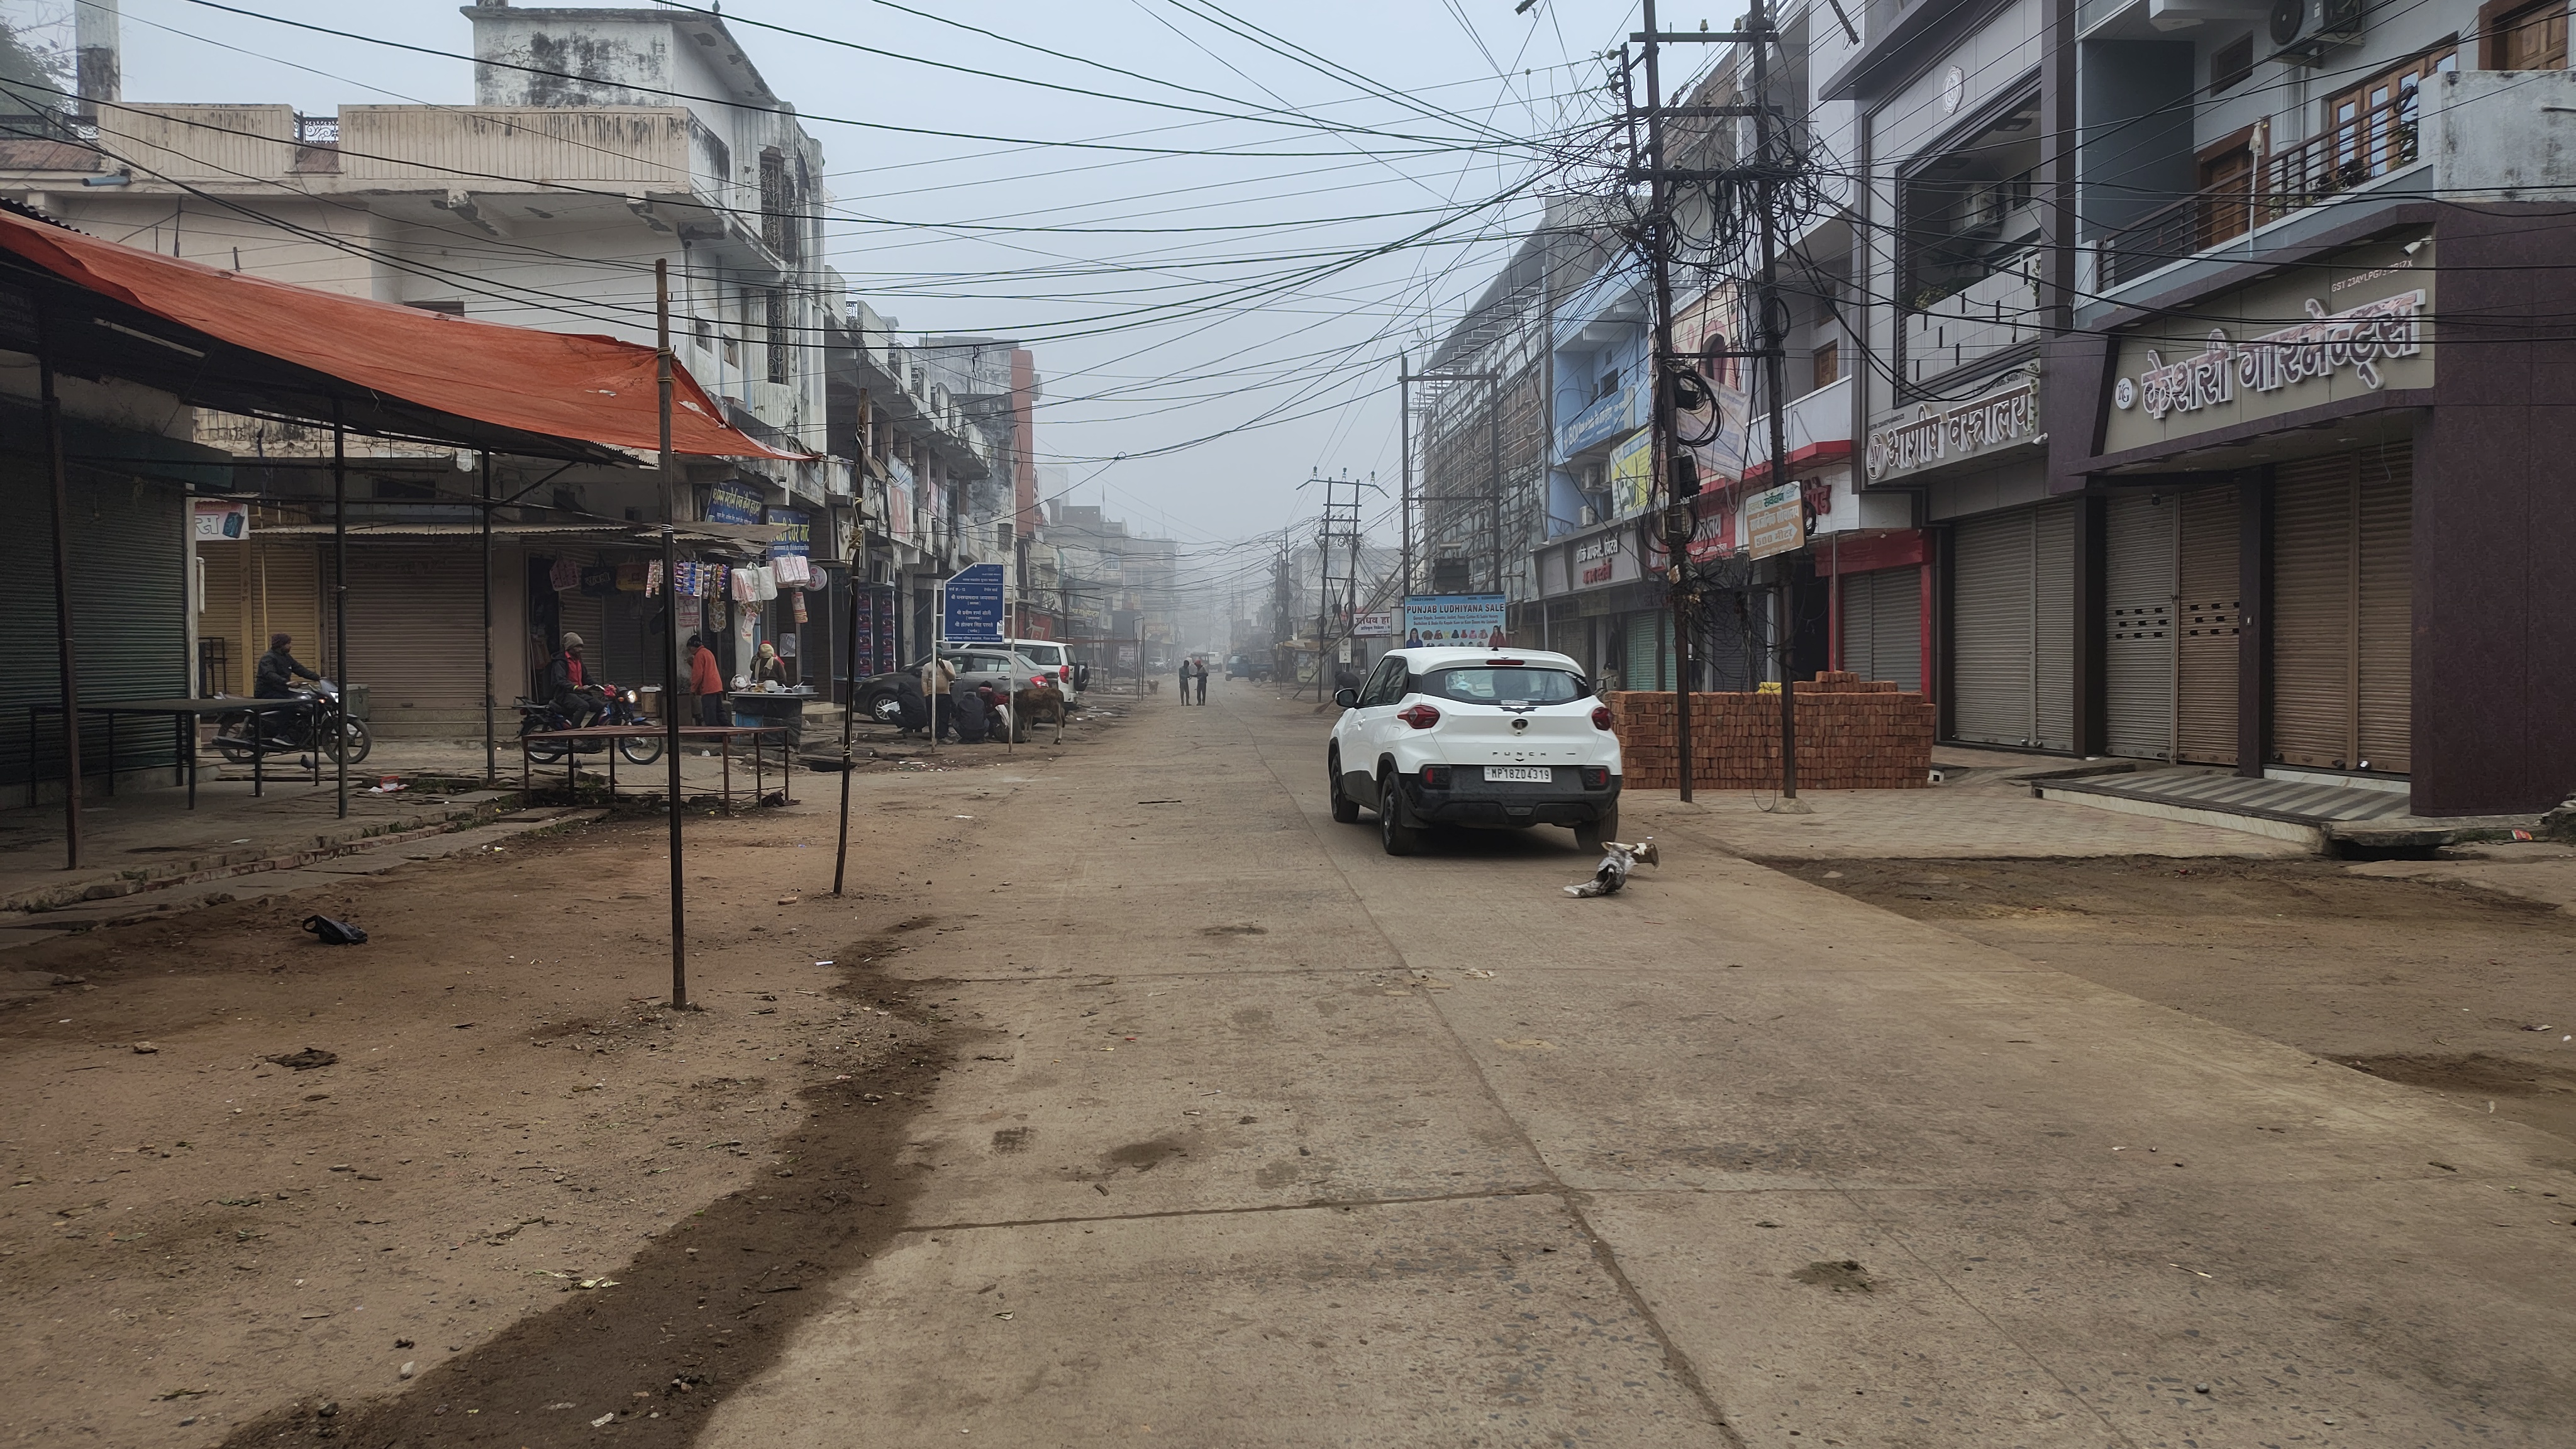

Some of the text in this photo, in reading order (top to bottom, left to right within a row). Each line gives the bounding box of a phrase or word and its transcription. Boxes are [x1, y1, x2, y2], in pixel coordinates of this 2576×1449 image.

[2331, 281, 2346, 292] GST
[2141, 328, 2236, 419] केशरी
[2116, 383, 2131, 403] KG
[1887, 383, 2035, 469] आशीष वस्त्रालय
[196, 514, 219, 535] स
[1756, 528, 1792, 547] 500 मीटर
[1407, 603, 1504, 614] PUNJAB LUDHIYANA SALE
[1380, 616, 1390, 625] हा
[1491, 767, 1550, 780] MP18ZD4319
